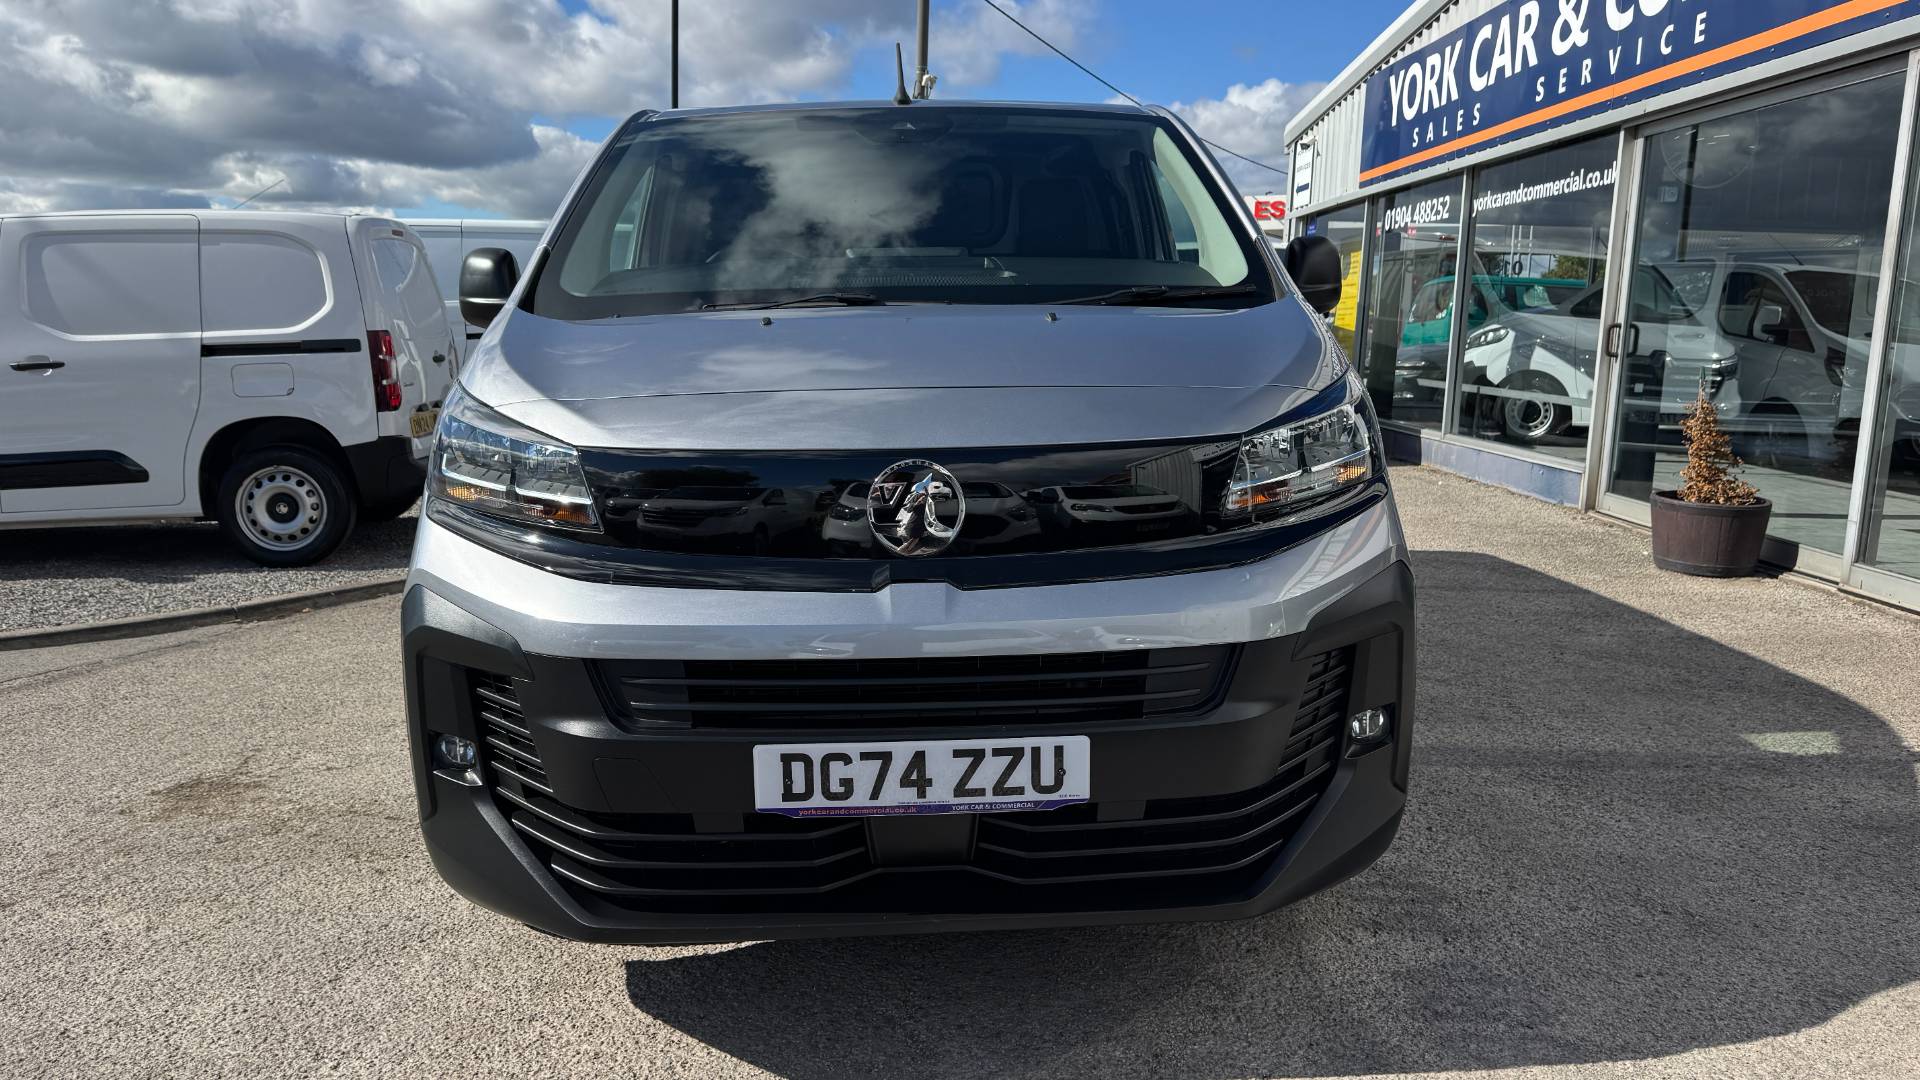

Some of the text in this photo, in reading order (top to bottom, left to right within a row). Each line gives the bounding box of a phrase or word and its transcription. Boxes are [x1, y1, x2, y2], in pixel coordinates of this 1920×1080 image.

[1389, 0, 1589, 127] YORK CAR &
[1412, 103, 1481, 148] SALES
[1535, 11, 1708, 102] SERVICE
[1254, 200, 1286, 220] ES
[1385, 195, 1450, 231] 01904 488252
[1472, 160, 1617, 217] yorkcarandcommercial.co.uk
[780, 745, 1065, 803] DG74 ZZU
[799, 805, 917, 817] yorkcarandcommercial.co.uk
